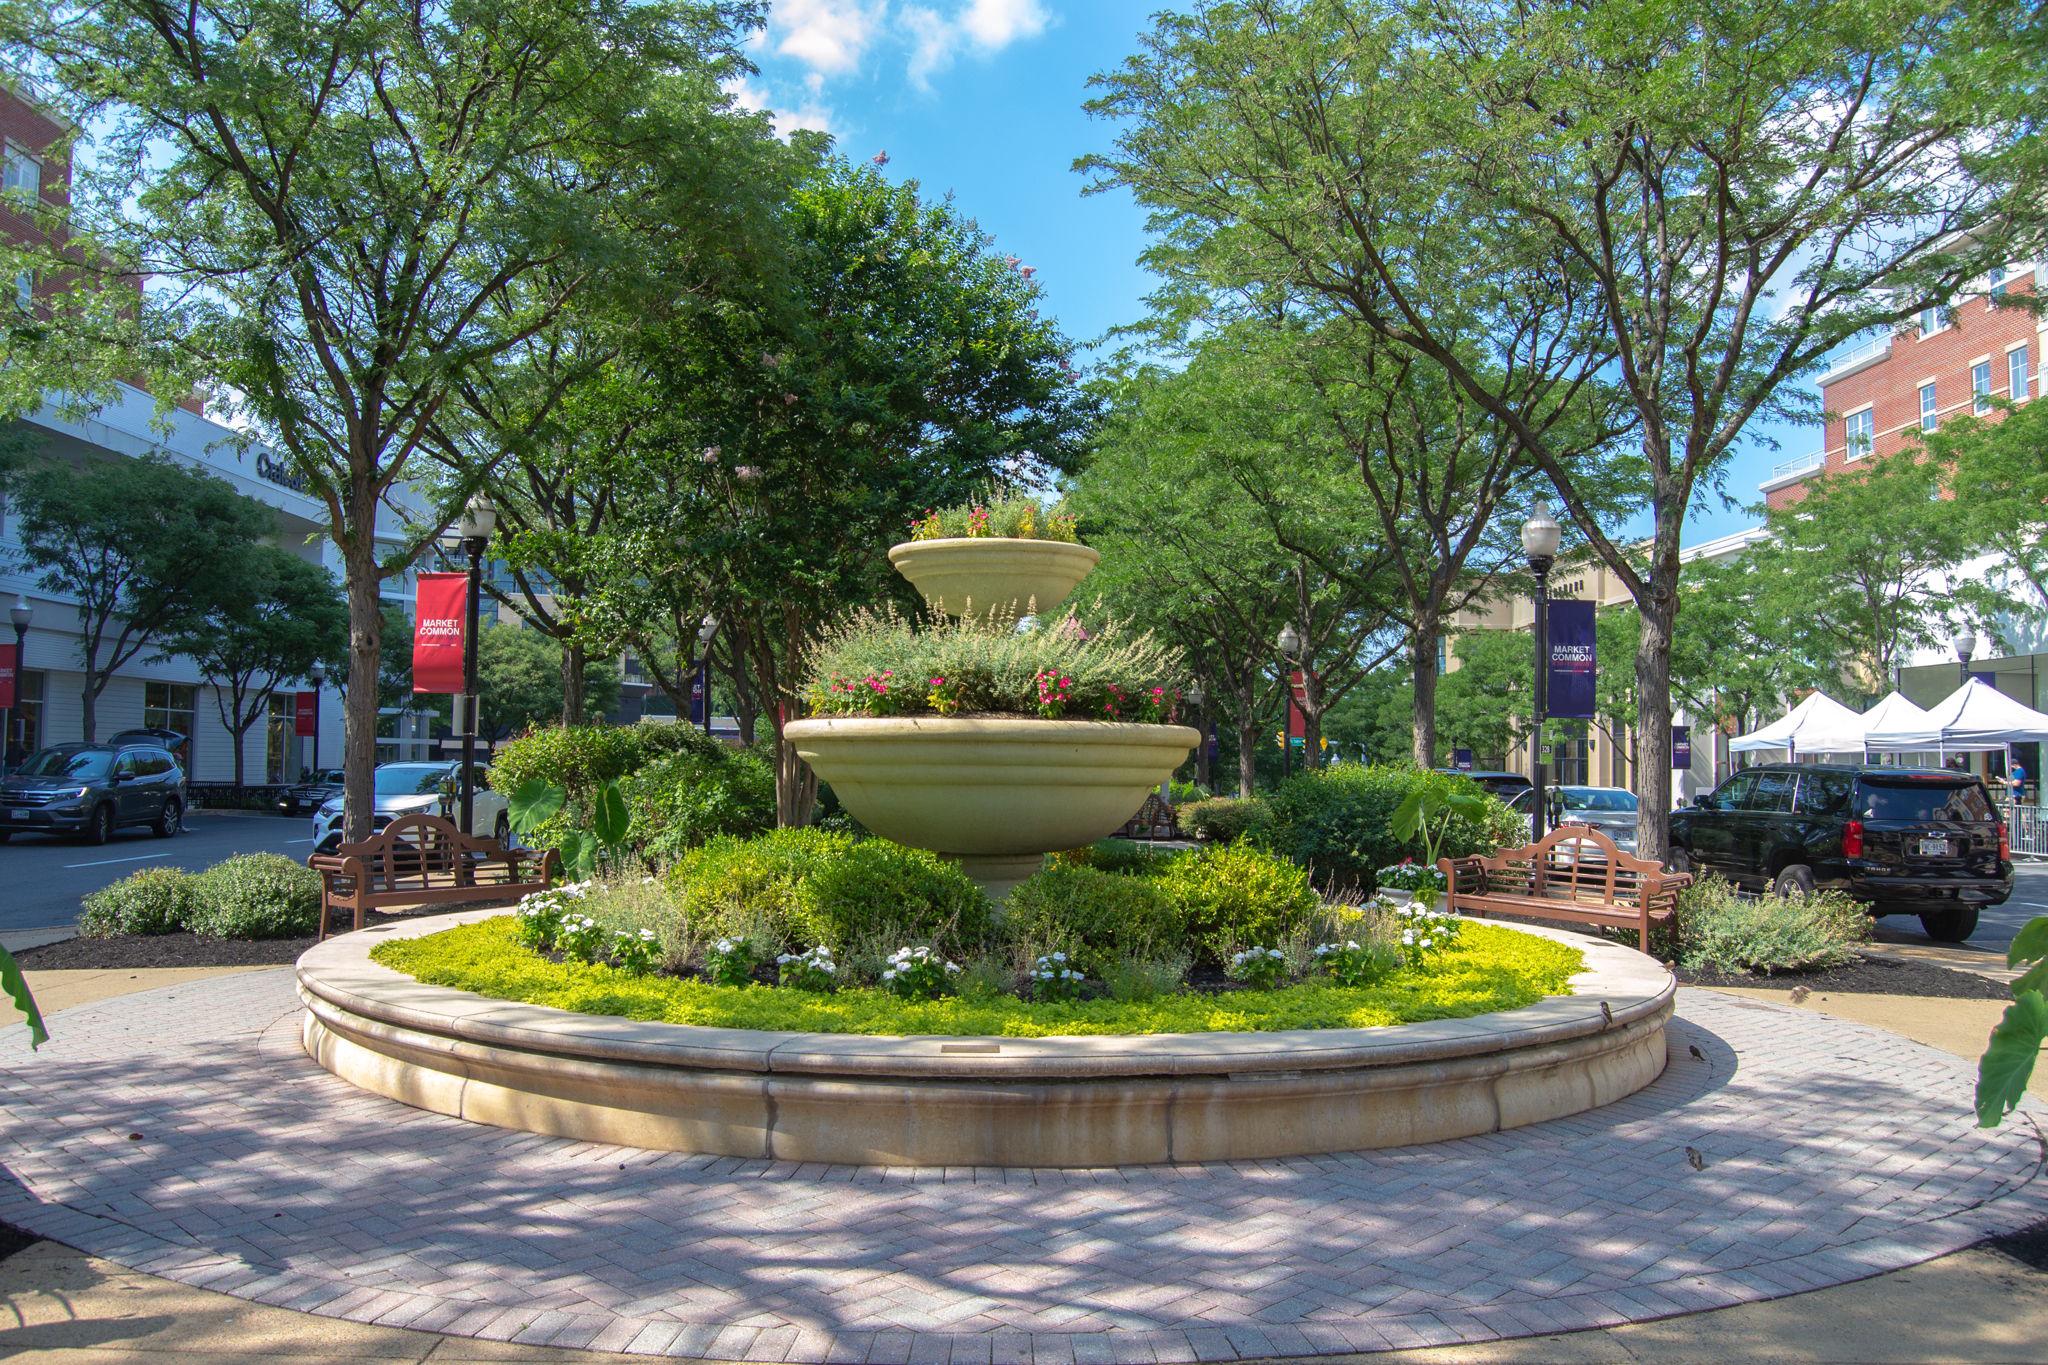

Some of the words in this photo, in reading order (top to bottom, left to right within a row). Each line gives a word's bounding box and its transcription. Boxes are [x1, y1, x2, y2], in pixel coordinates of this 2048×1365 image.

[422, 619, 458, 627] MARKET
[419, 627, 460, 636] COMMON
[1554, 645, 1590, 654] MARKET
[1551, 653, 1593, 662] COMMON
